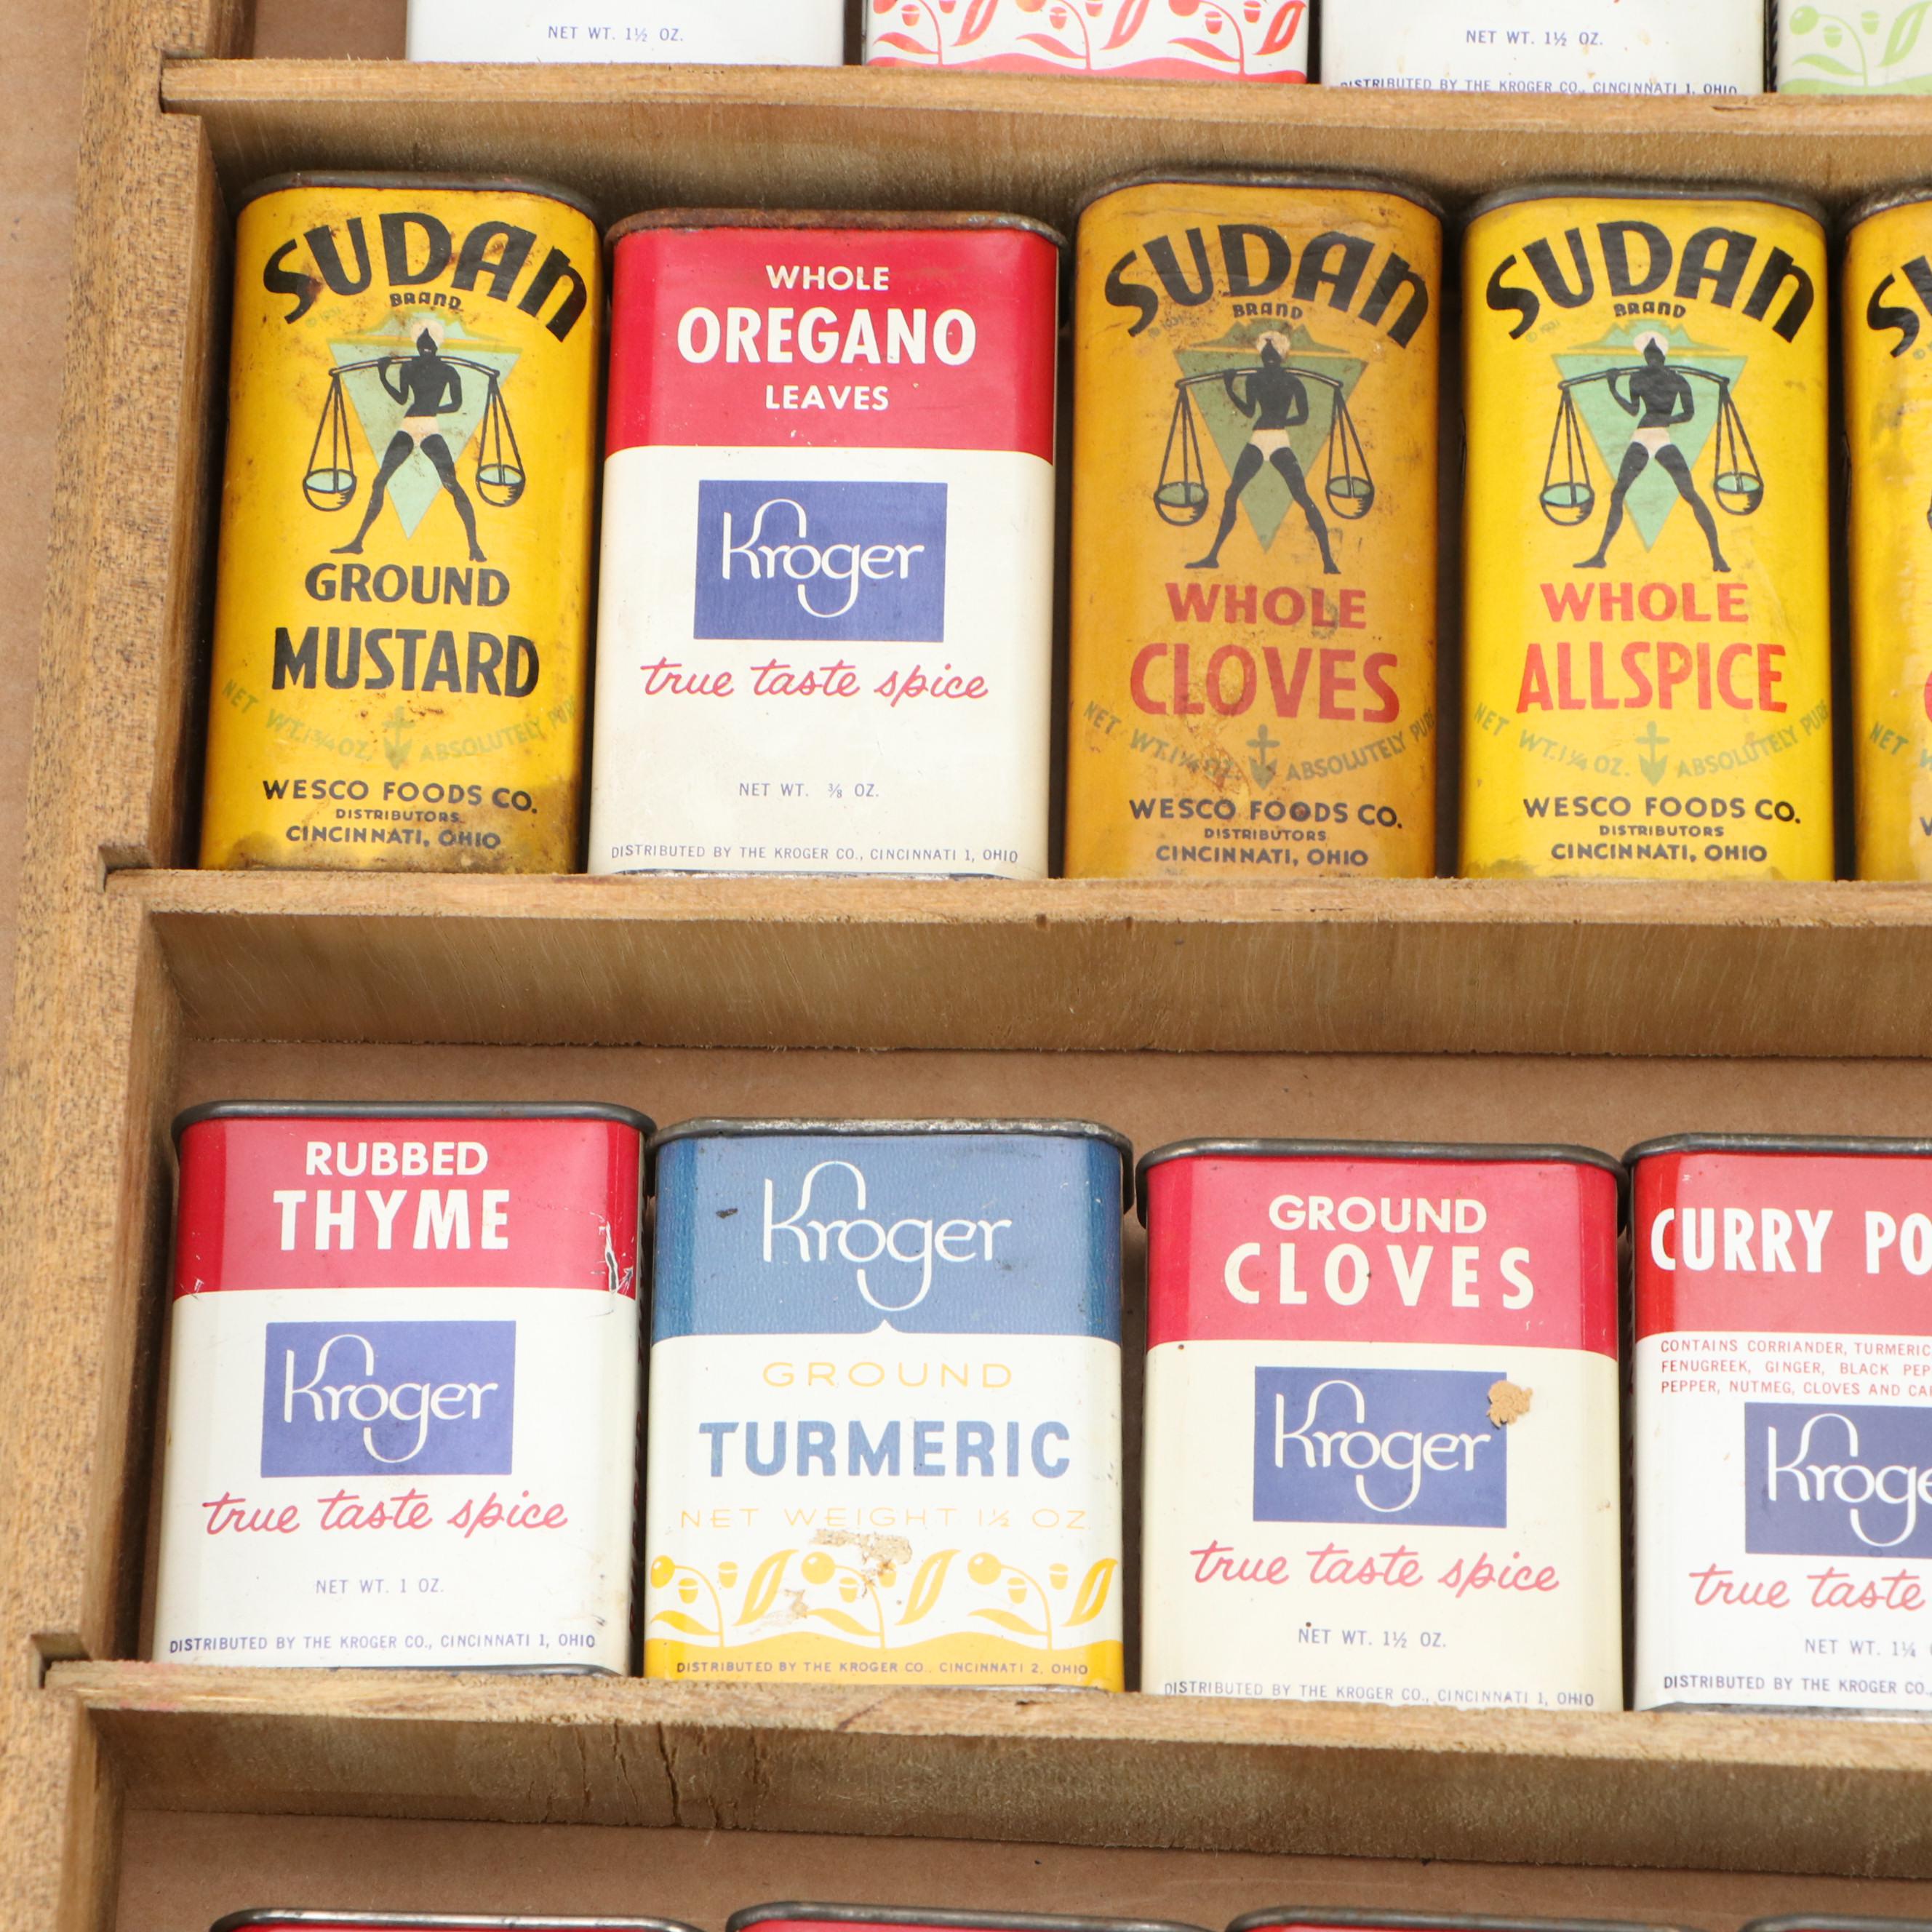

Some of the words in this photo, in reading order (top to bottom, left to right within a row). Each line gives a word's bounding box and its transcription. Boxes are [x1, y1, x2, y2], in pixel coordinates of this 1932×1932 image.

[548, 25, 578, 39] NET
[588, 26, 615, 40] WT.
[659, 28, 684, 41] OZ.
[1466, 30, 1496, 44] NET
[1506, 31, 1534, 44] WT.
[1578, 31, 1603, 45] OZ.
[1440, 79, 1458, 91] BY
[1465, 80, 1491, 92] THE
[1499, 81, 1552, 93] KROGER
[1593, 81, 1677, 95] CINCINNATI
[765, 265, 890, 291] WHOLE
[389, 292, 464, 312] BRAND
[1233, 301, 1303, 320] BRAND
[1614, 300, 1686, 319] BRAND
[676, 306, 977, 367] OREGANO
[765, 385, 890, 410] LEAVES
[722, 498, 925, 619] Kroger
[305, 563, 510, 607] GROUND
[1165, 582, 1367, 629] WHOLE
[1539, 582, 1749, 623] WHOLE
[271, 626, 540, 698] MUSTARD
[1516, 641, 1787, 714] ALLSPICE
[222, 679, 259, 714] NET
[640, 656, 735, 698] true
[749, 658, 861, 698] taste
[874, 663, 989, 708] spice
[1130, 642, 1400, 724] CLOVES
[1083, 700, 1122, 735] NET
[1474, 702, 1509, 736] NET
[420, 717, 546, 762] ABSOLUTELY
[1677, 724, 1798, 778] ABSOLUTELY
[1869, 721, 1909, 756] NET
[1286, 730, 1406, 781] ABSOLUTELY
[263, 779, 370, 801] WESCO
[383, 781, 482, 807] FOODS
[492, 789, 538, 815] CO.
[739, 783, 770, 797] NET
[781, 783, 809, 797] WT.
[854, 783, 879, 797] OZ.
[335, 808, 460, 823] DISTRIBUTORS
[1129, 798, 1236, 820] WESCO
[1250, 800, 1347, 824] FOODS
[1357, 803, 1402, 829] CO.
[1523, 797, 1631, 818] WESCO
[1645, 797, 1746, 819] FOODS
[1755, 799, 1801, 824] CO.
[285, 826, 431, 849] CINCINNATI,
[438, 830, 501, 850] OHIO
[1204, 827, 1327, 842] DISTRIBUTORS
[1600, 824, 1725, 838] DISTRIBUTORS
[612, 844, 705, 859] DISTRIBUTED
[713, 846, 732, 858] BY
[739, 847, 766, 859] THE
[774, 847, 829, 861] KROGER
[837, 847, 863, 862] CO.,
[870, 848, 957, 861] CINCINNATI
[982, 849, 1018, 864] OHIO
[1156, 845, 1299, 866] CINCINNATI,
[1306, 848, 1369, 866] OHIO
[1551, 843, 1697, 863] CINCINNATI,
[1704, 844, 1768, 863] OHIO
[306, 1141, 488, 1176] RUBBED
[273, 1189, 509, 1250] THYME
[1269, 1194, 1487, 1234] GROUND
[763, 1160, 1013, 1312] Kroger
[1650, 1208, 1834, 1273] CURRY
[1224, 1242, 1534, 1310] CLOVES
[1661, 1339, 1739, 1354] CONTAINS
[1747, 1340, 1848, 1357] CORRIANDER,
[762, 1362, 1012, 1388] GROUND
[1661, 1360, 1752, 1374] FENUGREEK,
[1765, 1361, 1825, 1376] GINGER,
[1840, 1362, 1889, 1376] BLACK
[284, 1333, 498, 1463] Kroger
[1661, 1380, 1720, 1395] PEPPER,
[1729, 1381, 1795, 1396] NUTMEG,
[1803, 1381, 1861, 1396] CLOVES
[1869, 1383, 1901, 1397] AND
[699, 1421, 1070, 1478] TURMERIC
[1275, 1379, 1491, 1512] Kroger
[202, 1491, 300, 1535] true
[317, 1488, 433, 1531] taste
[446, 1490, 568, 1538] spice
[680, 1509, 759, 1528] NET
[784, 1507, 958, 1528] WEIGHT
[1031, 1509, 1087, 1529] OZ
[1190, 1540, 1290, 1585] true
[1306, 1543, 1424, 1587] taste
[1438, 1551, 1560, 1598] spice
[315, 1578, 348, 1594] NET
[359, 1578, 389, 1594] WT.
[399, 1578, 407, 1594] 1
[418, 1578, 444, 1594] OZ.
[1688, 1563, 1790, 1609] true
[1807, 1566, 1926, 1611] taste
[169, 1637, 267, 1653] DISTRIBUTED
[276, 1636, 295, 1650] BY
[304, 1635, 331, 1650] THE
[340, 1634, 397, 1649] KROGER
[404, 1634, 432, 1650] CO.,
[440, 1633, 530, 1648] CINCINNATI
[558, 1633, 595, 1648] OHIO
[1298, 1629, 1331, 1644] NET
[1342, 1629, 1372, 1645] WT.
[1419, 1632, 1447, 1648] OZ.
[1805, 1638, 1838, 1654] NET
[1850, 1640, 1880, 1656] WT.
[676, 1661, 772, 1673] DISTRIBUTED
[779, 1661, 797, 1673] BY
[803, 1661, 831, 1673] THE
[839, 1662, 898, 1673] KROGER
[939, 1662, 1023, 1674] CINCINNATI
[1051, 1663, 1088, 1675] OHIO
[1165, 1681, 1263, 1696] DISTRIBUTED
[1273, 1684, 1292, 1696] BY
[1301, 1685, 1328, 1698] THE
[1336, 1686, 1393, 1700] KROGER
[1402, 1688, 1429, 1703] CO.,
[1437, 1689, 1529, 1704] CINCINNATI
[1557, 1692, 1594, 1707] OHIO
[1664, 1675, 1765, 1691] DISTRIBUTED
[1774, 1677, 1793, 1691] BY
[1803, 1678, 1830, 1692] THE
[1839, 1679, 1897, 1694] KROGER
